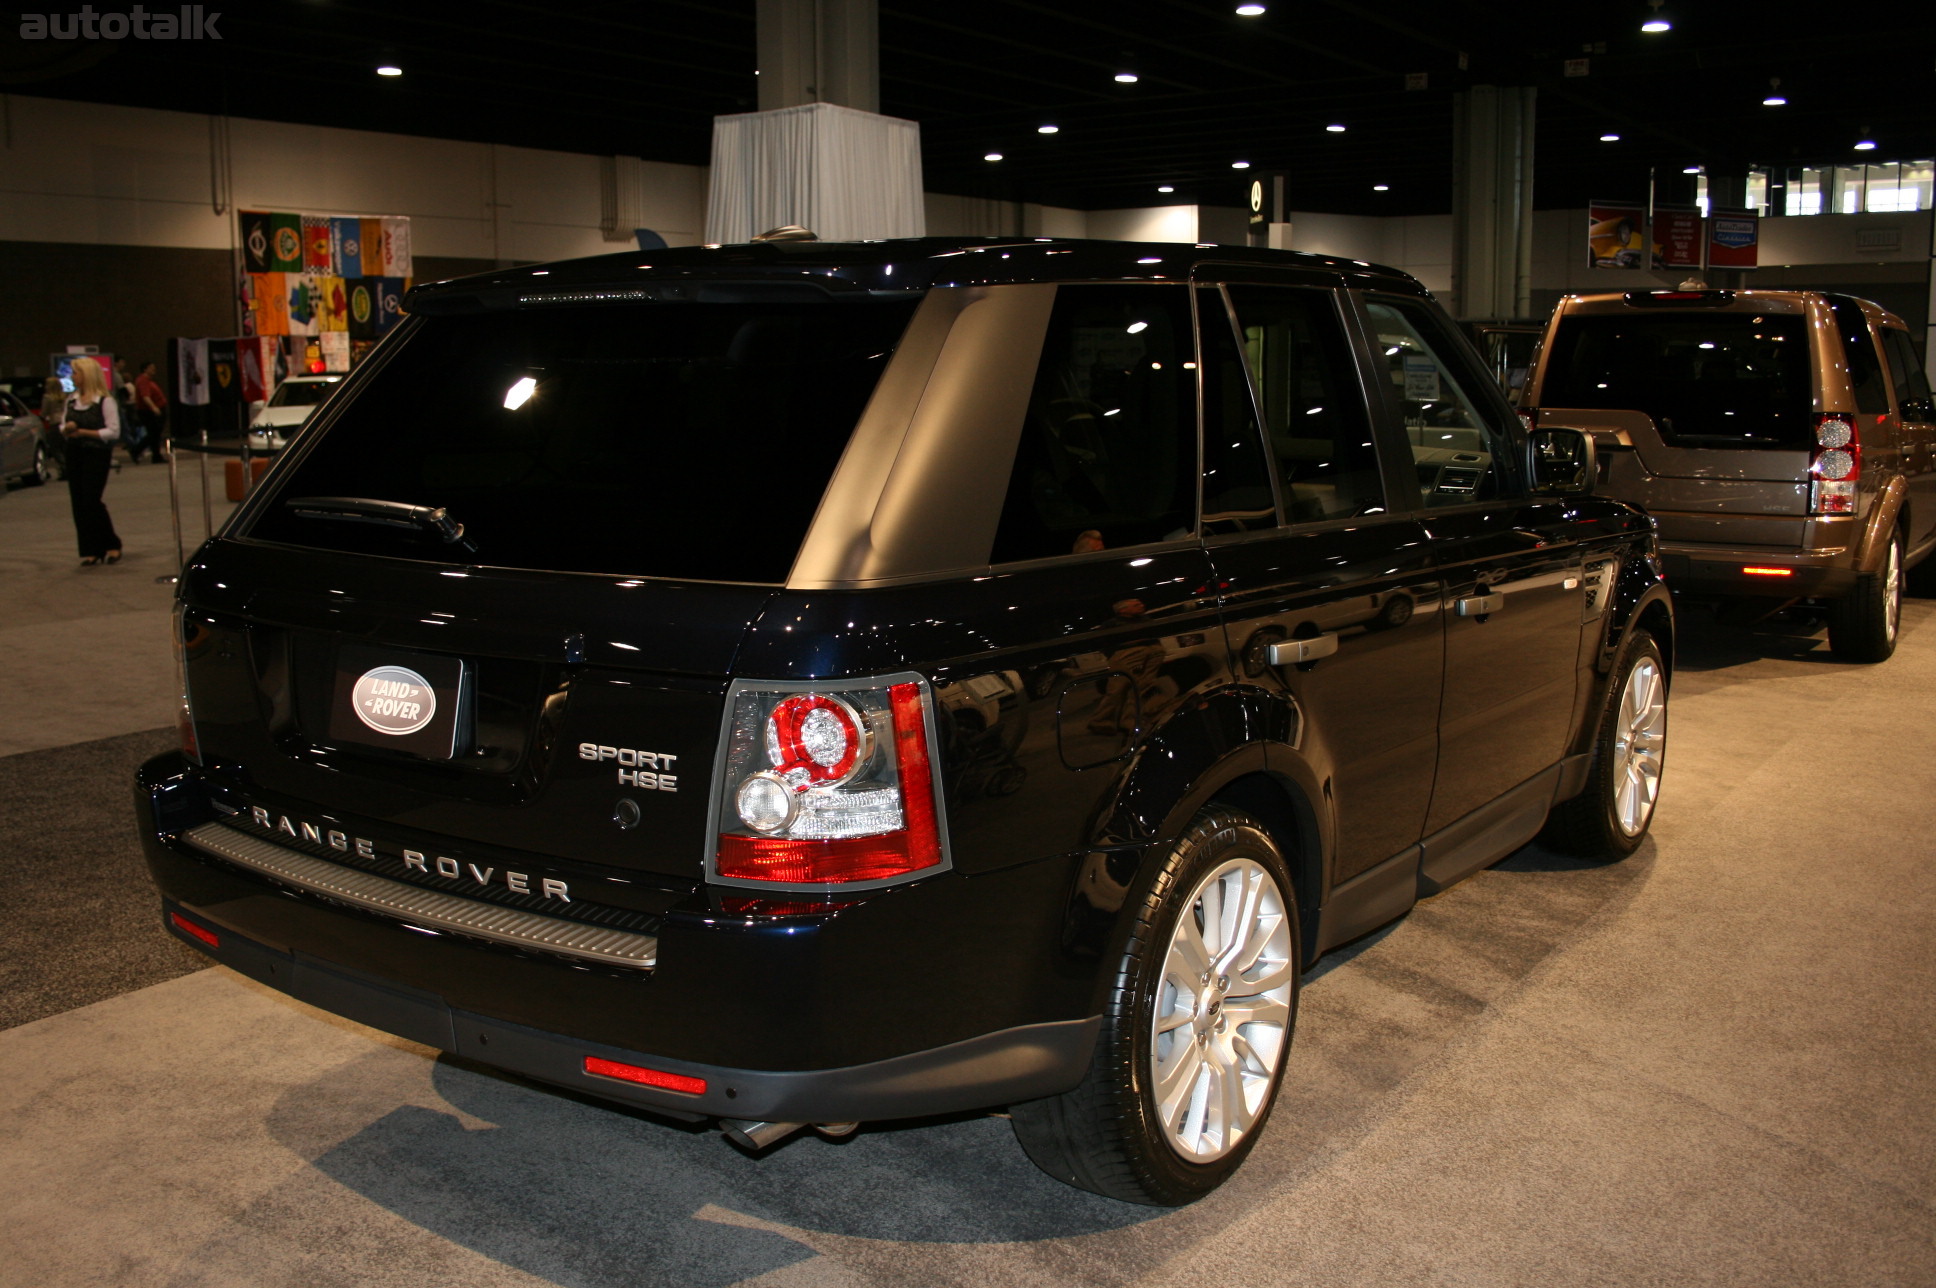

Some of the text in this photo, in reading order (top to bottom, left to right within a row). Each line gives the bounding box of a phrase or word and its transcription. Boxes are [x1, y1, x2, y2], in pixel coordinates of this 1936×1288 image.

[371, 678, 410, 699] LAND
[372, 698, 420, 720] ROVER
[579, 742, 677, 771] SPORT
[618, 768, 678, 792] HSE
[252, 805, 571, 903] RANGE ROVER
